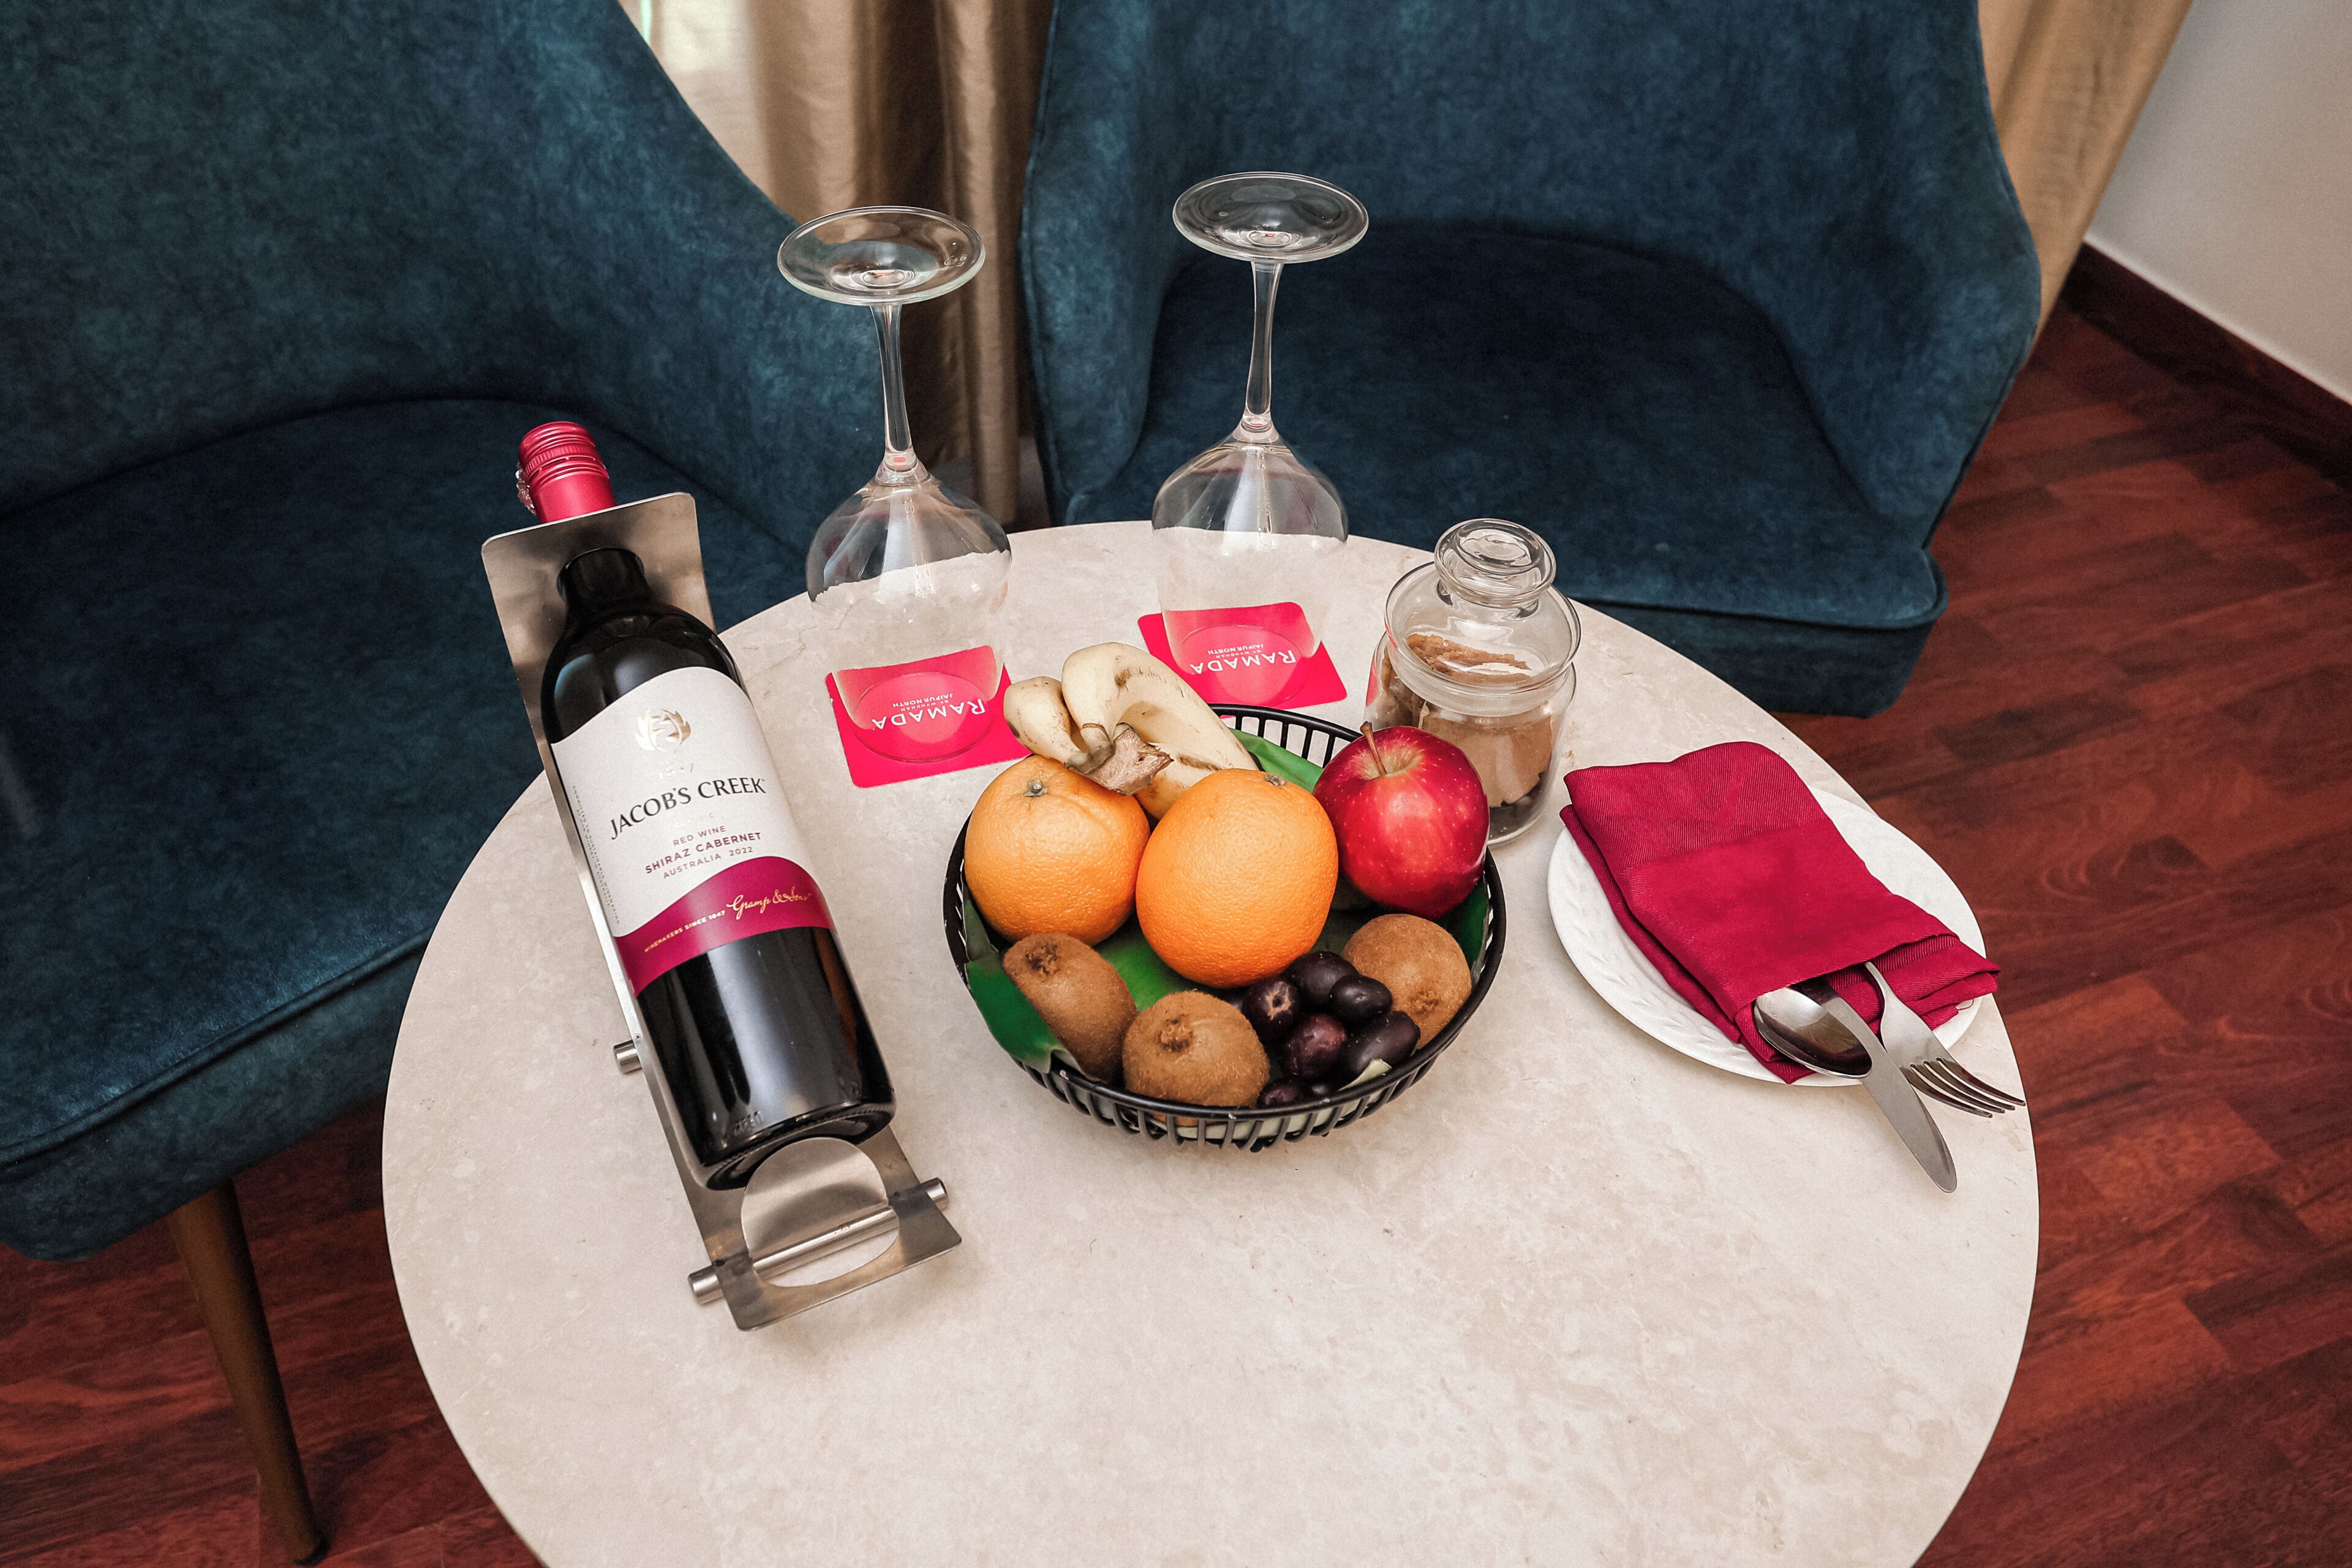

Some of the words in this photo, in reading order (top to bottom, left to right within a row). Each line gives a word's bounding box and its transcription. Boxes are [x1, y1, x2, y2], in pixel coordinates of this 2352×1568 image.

[1189, 649, 1297, 674] RAMADA
[892, 698, 922, 707] NORTH
[900, 702, 937, 711] WYNDHAM
[924, 693, 954, 703] JAIPUR
[872, 698, 986, 729] RAMADA
[610, 787, 692, 840] JACOB'S
[673, 834, 693, 846] RED
[698, 825, 726, 838] WINE
[645, 849, 691, 874] SHIRAZ
[696, 832, 762, 852] CABERNET
[663, 853, 722, 879] AUSTRALIA
[729, 846, 753, 856] 2022
[684, 917, 707, 930] SINCE
[708, 910, 726, 920] 1847
